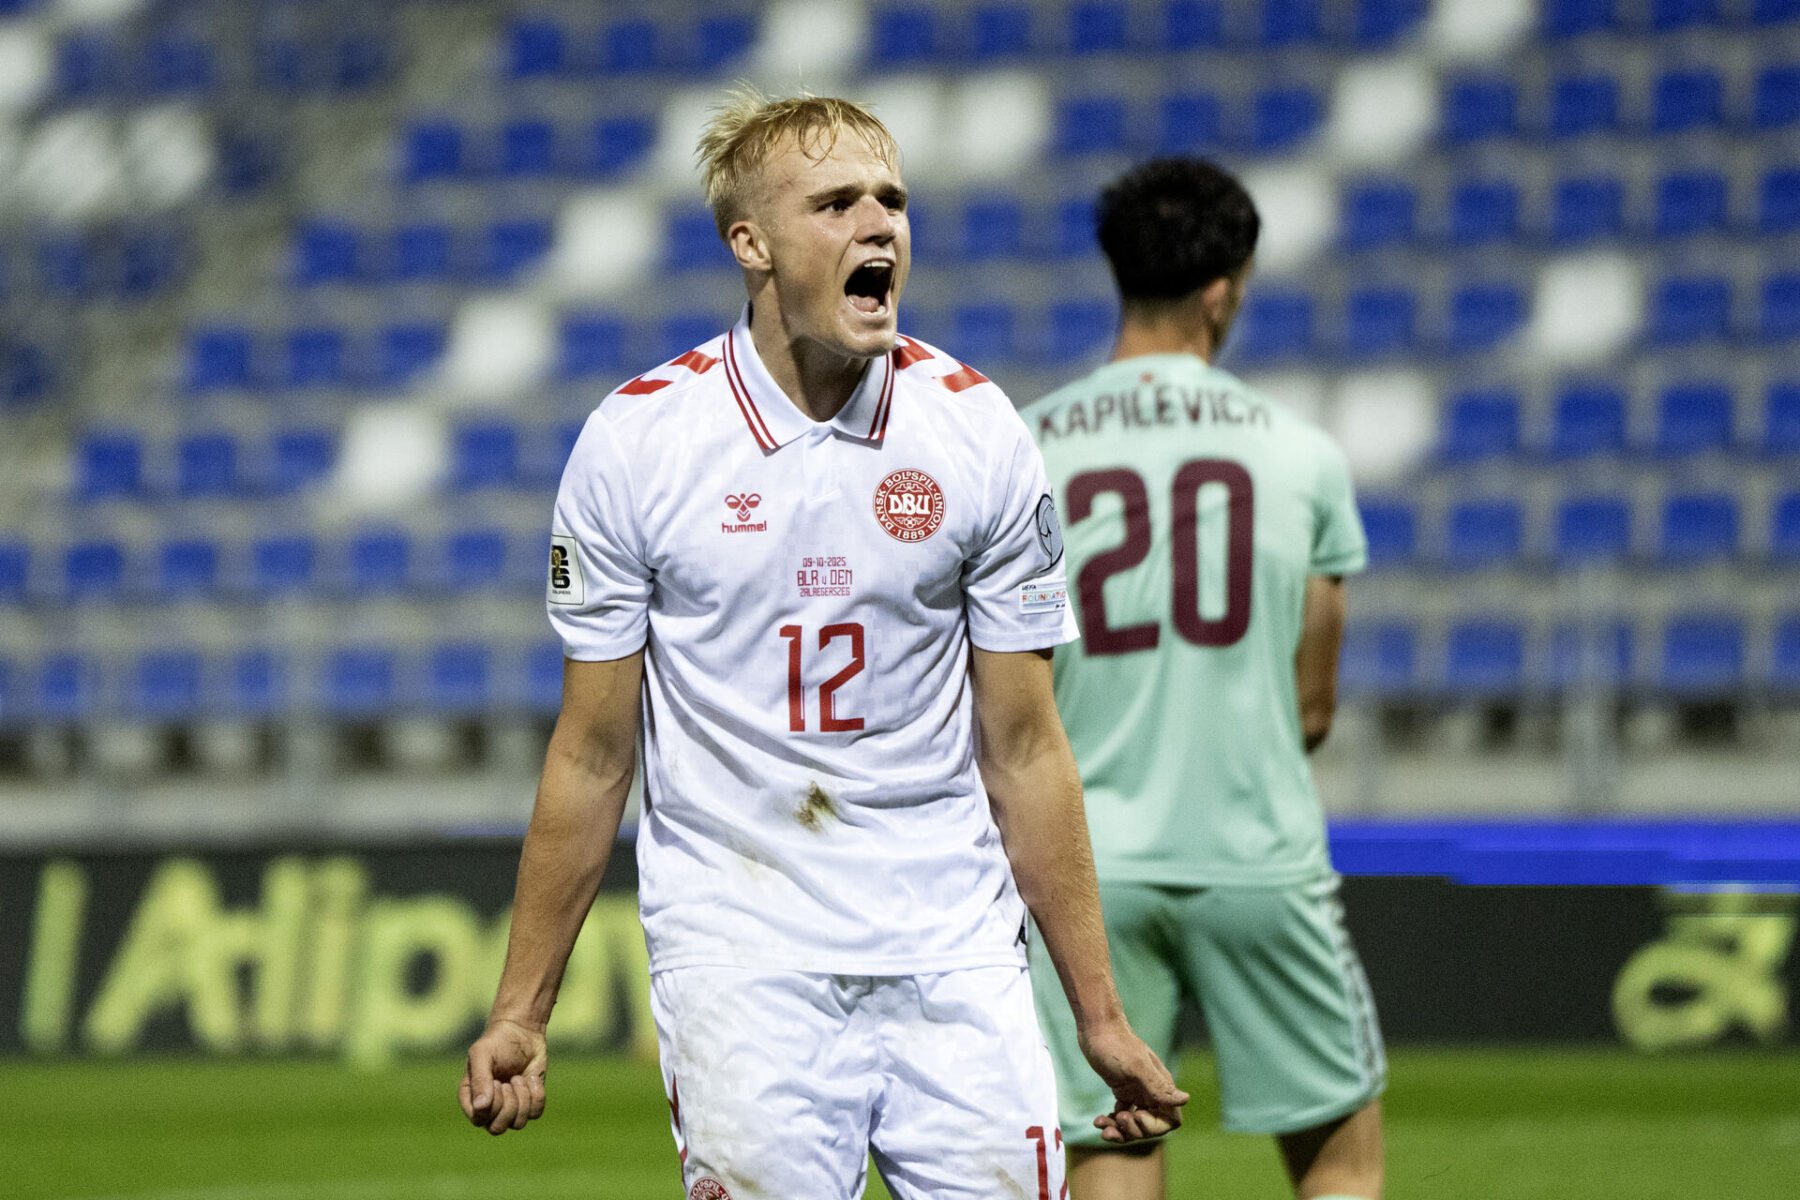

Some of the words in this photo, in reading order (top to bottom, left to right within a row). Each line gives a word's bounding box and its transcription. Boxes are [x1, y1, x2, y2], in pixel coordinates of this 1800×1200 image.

[876, 489, 895, 530] DANSK
[888, 493, 931, 515] DBU
[927, 492, 944, 531] UNION
[722, 520, 767, 533] hummel
[897, 530, 926, 539] 1889
[803, 557, 847, 567] 09-10-2025
[1065, 458, 1254, 658] 20
[797, 570, 819, 586] BLR
[830, 569, 853, 585] DEN
[1022, 591, 1066, 601] FOUNDATIO
[779, 622, 865, 732] 12
